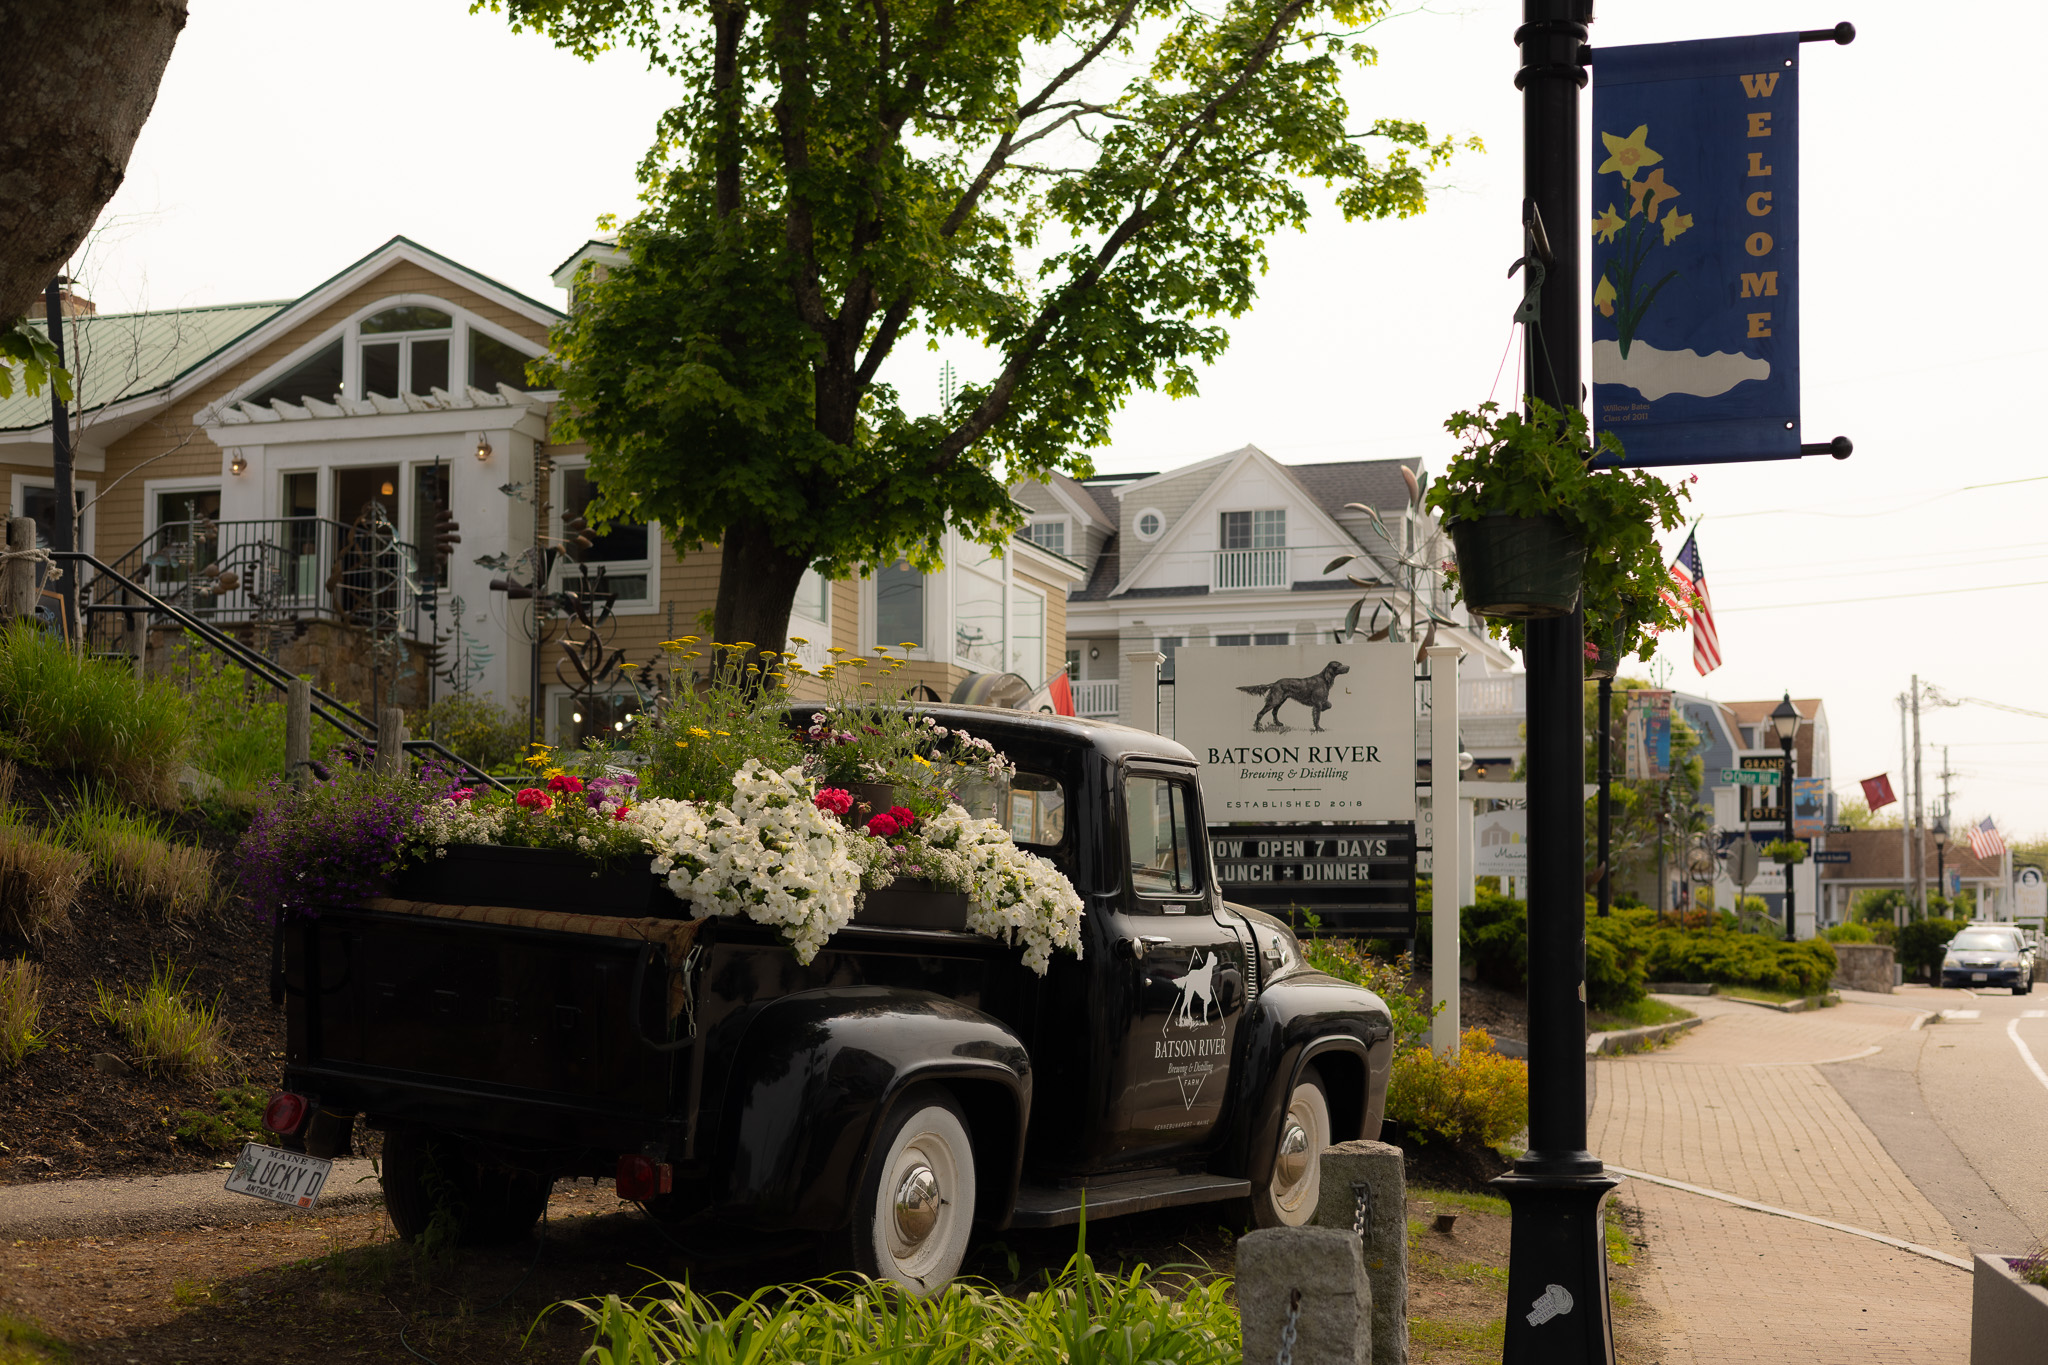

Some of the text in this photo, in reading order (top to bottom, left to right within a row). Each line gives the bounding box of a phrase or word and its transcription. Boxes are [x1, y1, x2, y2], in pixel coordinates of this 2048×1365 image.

[1740, 72, 1780, 339] WELCOME
[1603, 403, 1650, 412] Willow Bates
[1603, 412, 1648, 422] Class of 2011
[1207, 745, 1382, 765] BATSON RIVER
[1744, 759, 1785, 770] GRAND
[1240, 767, 1349, 782] Brewing & Distilling
[1226, 800, 1363, 809] ESTABLISHED 2018
[1744, 808, 1785, 819] OTE
[1258, 840, 1304, 858] OPEN
[1314, 840, 1325, 857] 7
[1337, 839, 1387, 857] DAYS
[1215, 864, 1274, 881] LUNCH
[1303, 863, 1369, 881] DINNER
[1154, 1038, 1226, 1058] BATSON RIVER
[1168, 1060, 1214, 1076] Brewing & Distilling
[1184, 1078, 1200, 1087] FARM
[268, 1151, 309, 1166] MAINE
[247, 1158, 322, 1196] LUCKY D
[245, 1184, 275, 1198] ANTIQUE
[1532, 1295, 1548, 1308] CAPE
[1527, 1300, 1553, 1321] HARVEST
[1530, 1306, 1557, 1326] OYSTERS
